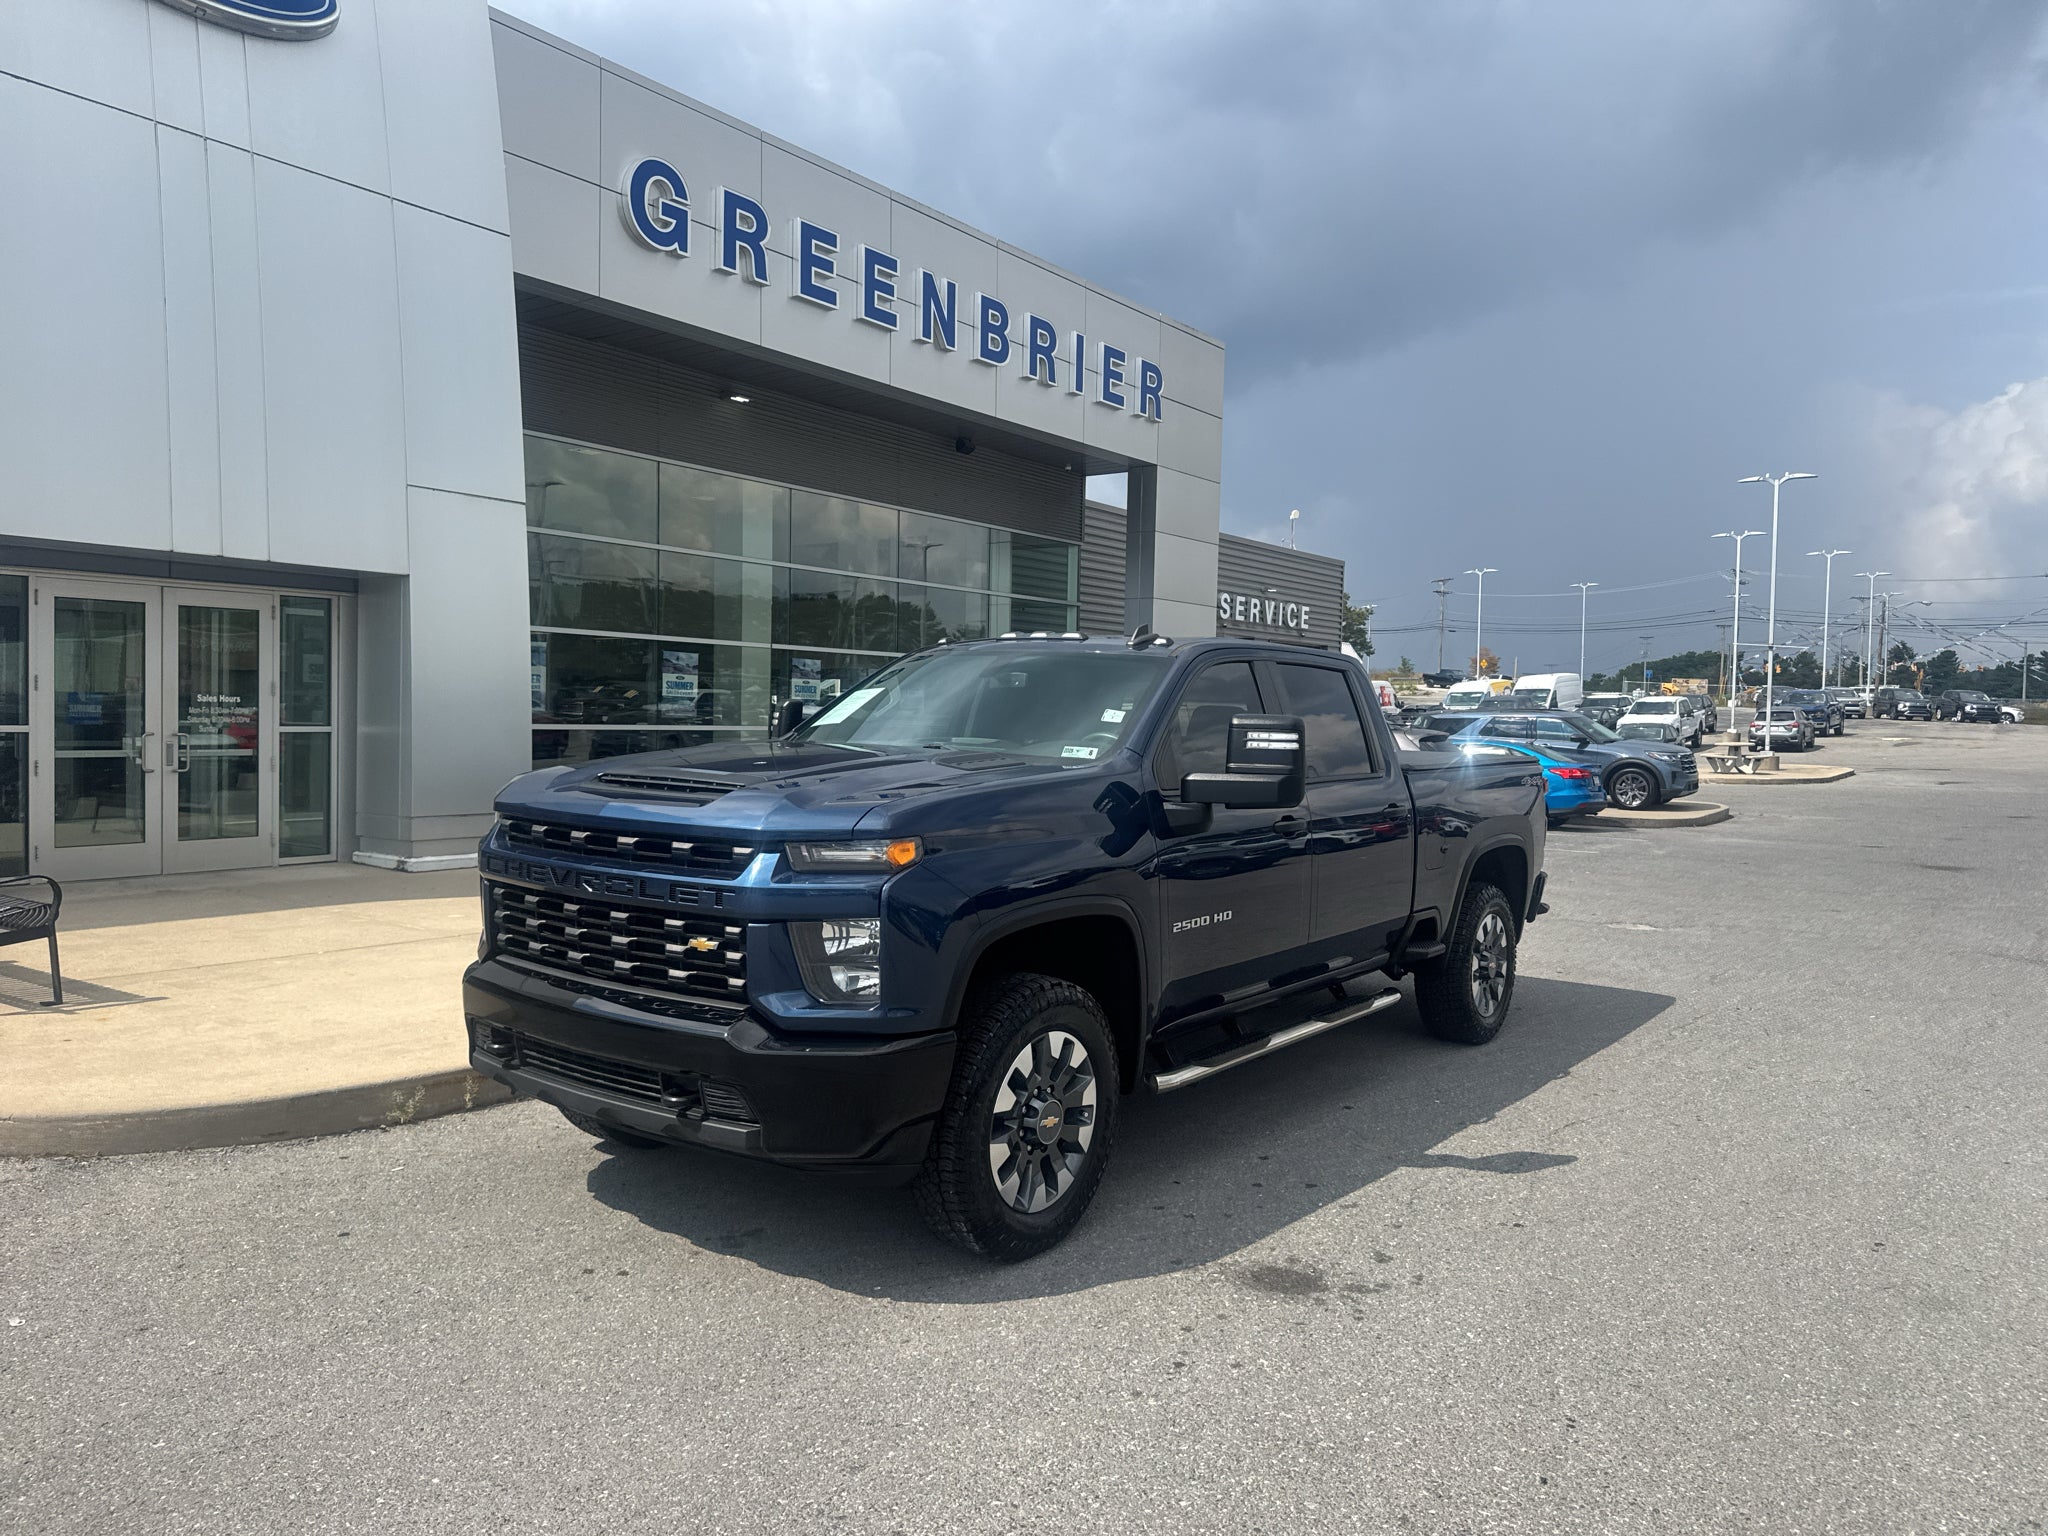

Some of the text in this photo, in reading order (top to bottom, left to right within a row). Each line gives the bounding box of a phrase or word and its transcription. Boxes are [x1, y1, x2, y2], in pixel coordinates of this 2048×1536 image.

[621, 156, 1164, 422] GREENBRIER
[1220, 592, 1310, 629] SERVICE
[197, 694, 241, 703] Sales Hours
[665, 680, 694, 690] SUMMER
[486, 854, 736, 909] CHEVROLET
[1173, 910, 1232, 933] 2500 HD
